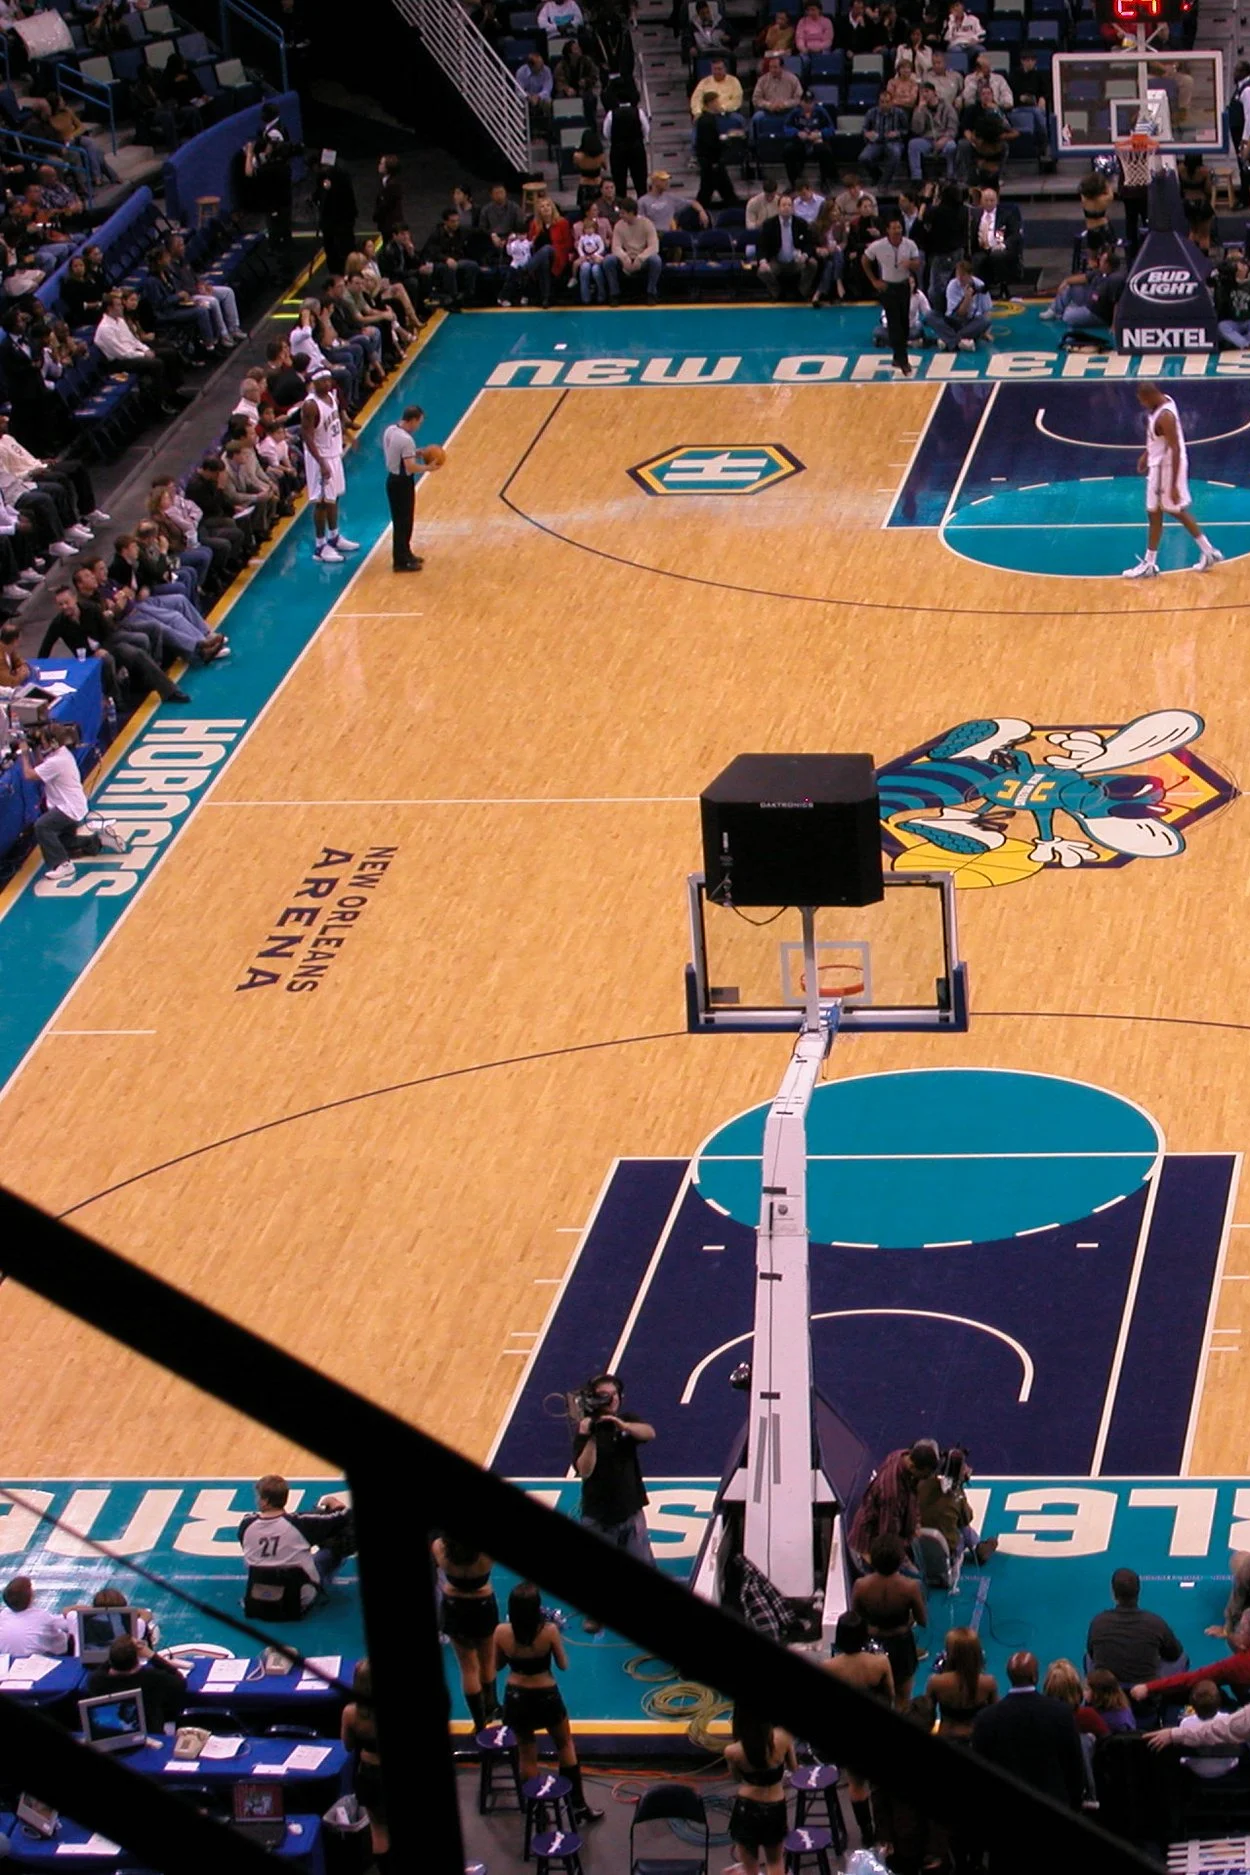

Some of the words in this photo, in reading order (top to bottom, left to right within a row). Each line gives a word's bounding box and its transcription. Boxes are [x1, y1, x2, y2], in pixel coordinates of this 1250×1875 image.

[1147, 270, 1191, 283] BUD
[1139, 282, 1199, 295] LIGHT
[1122, 327, 1214, 348] NEXTEL
[347, 846, 399, 889] NEW
[234, 846, 355, 993] ARENA
[285, 895, 369, 993] ORLEANS
[258, 1536, 280, 1558] 27
